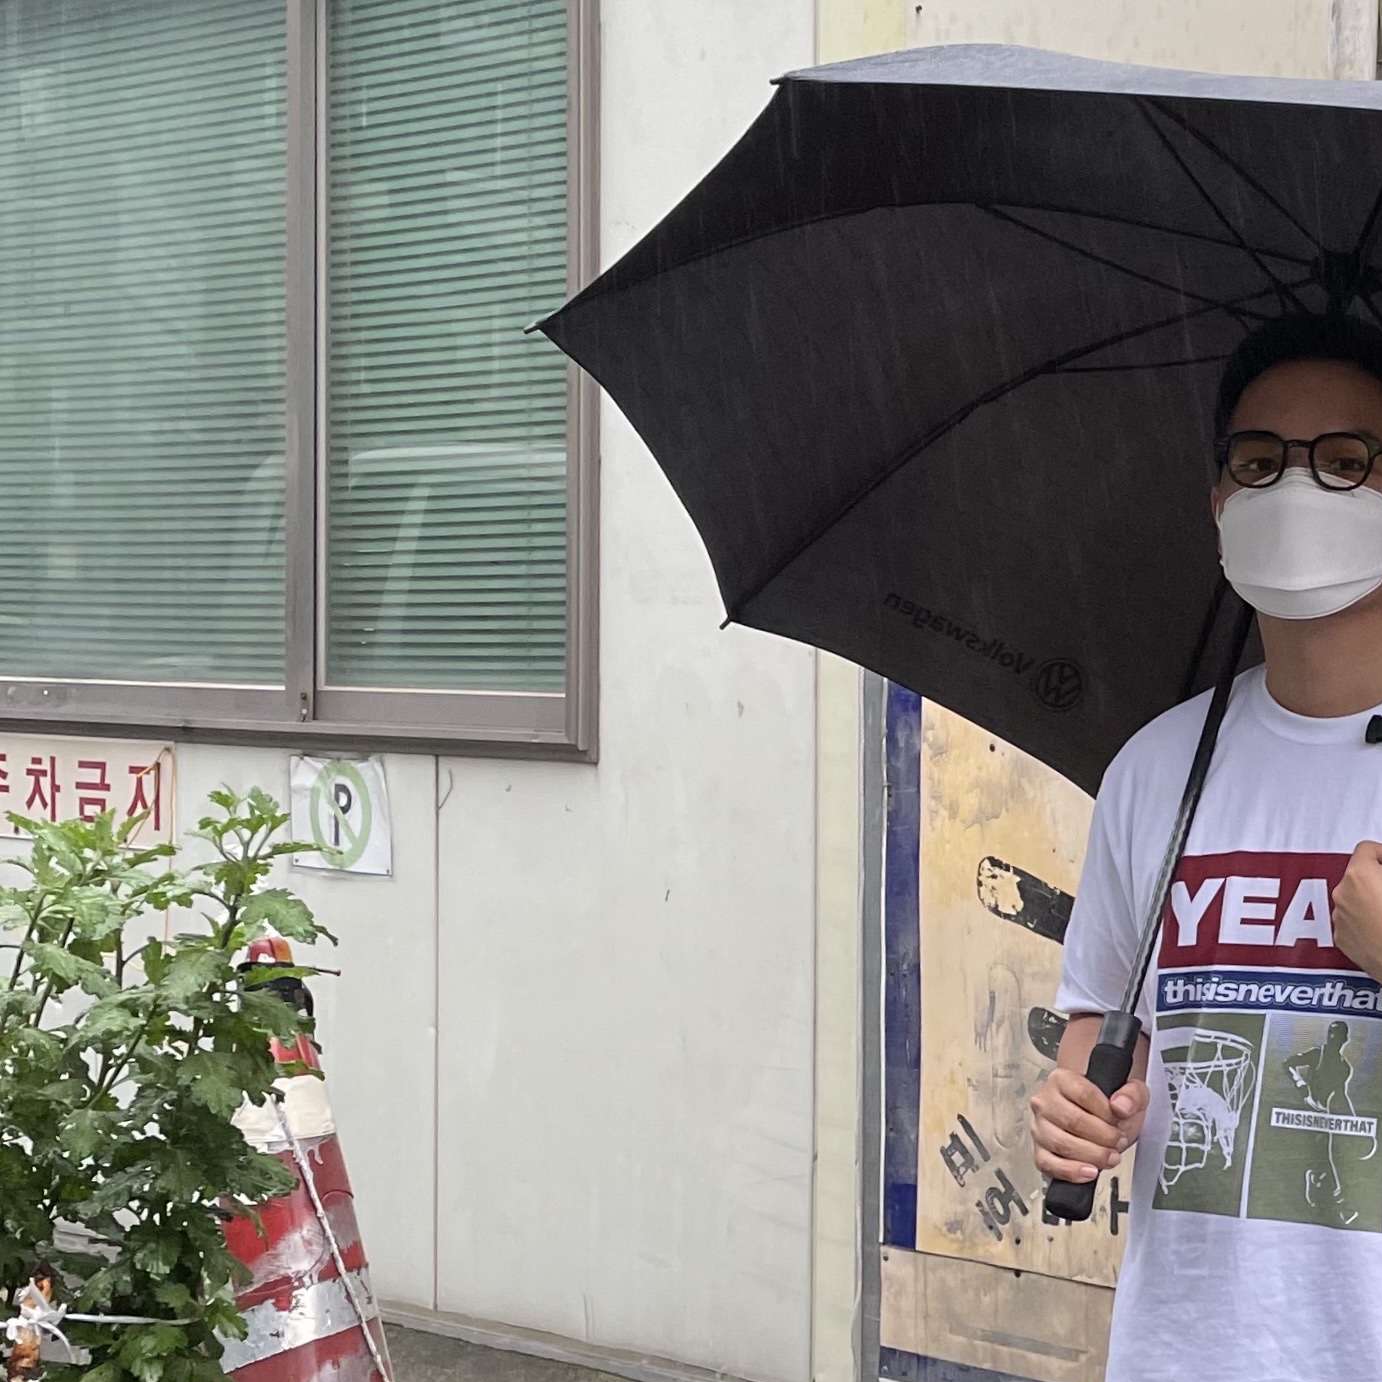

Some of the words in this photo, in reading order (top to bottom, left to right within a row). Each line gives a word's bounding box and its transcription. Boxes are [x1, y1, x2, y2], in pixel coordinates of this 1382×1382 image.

[0, 754, 161, 831] 차금지
[334, 783, 352, 846] P
[1170, 875, 1335, 948] YEA
